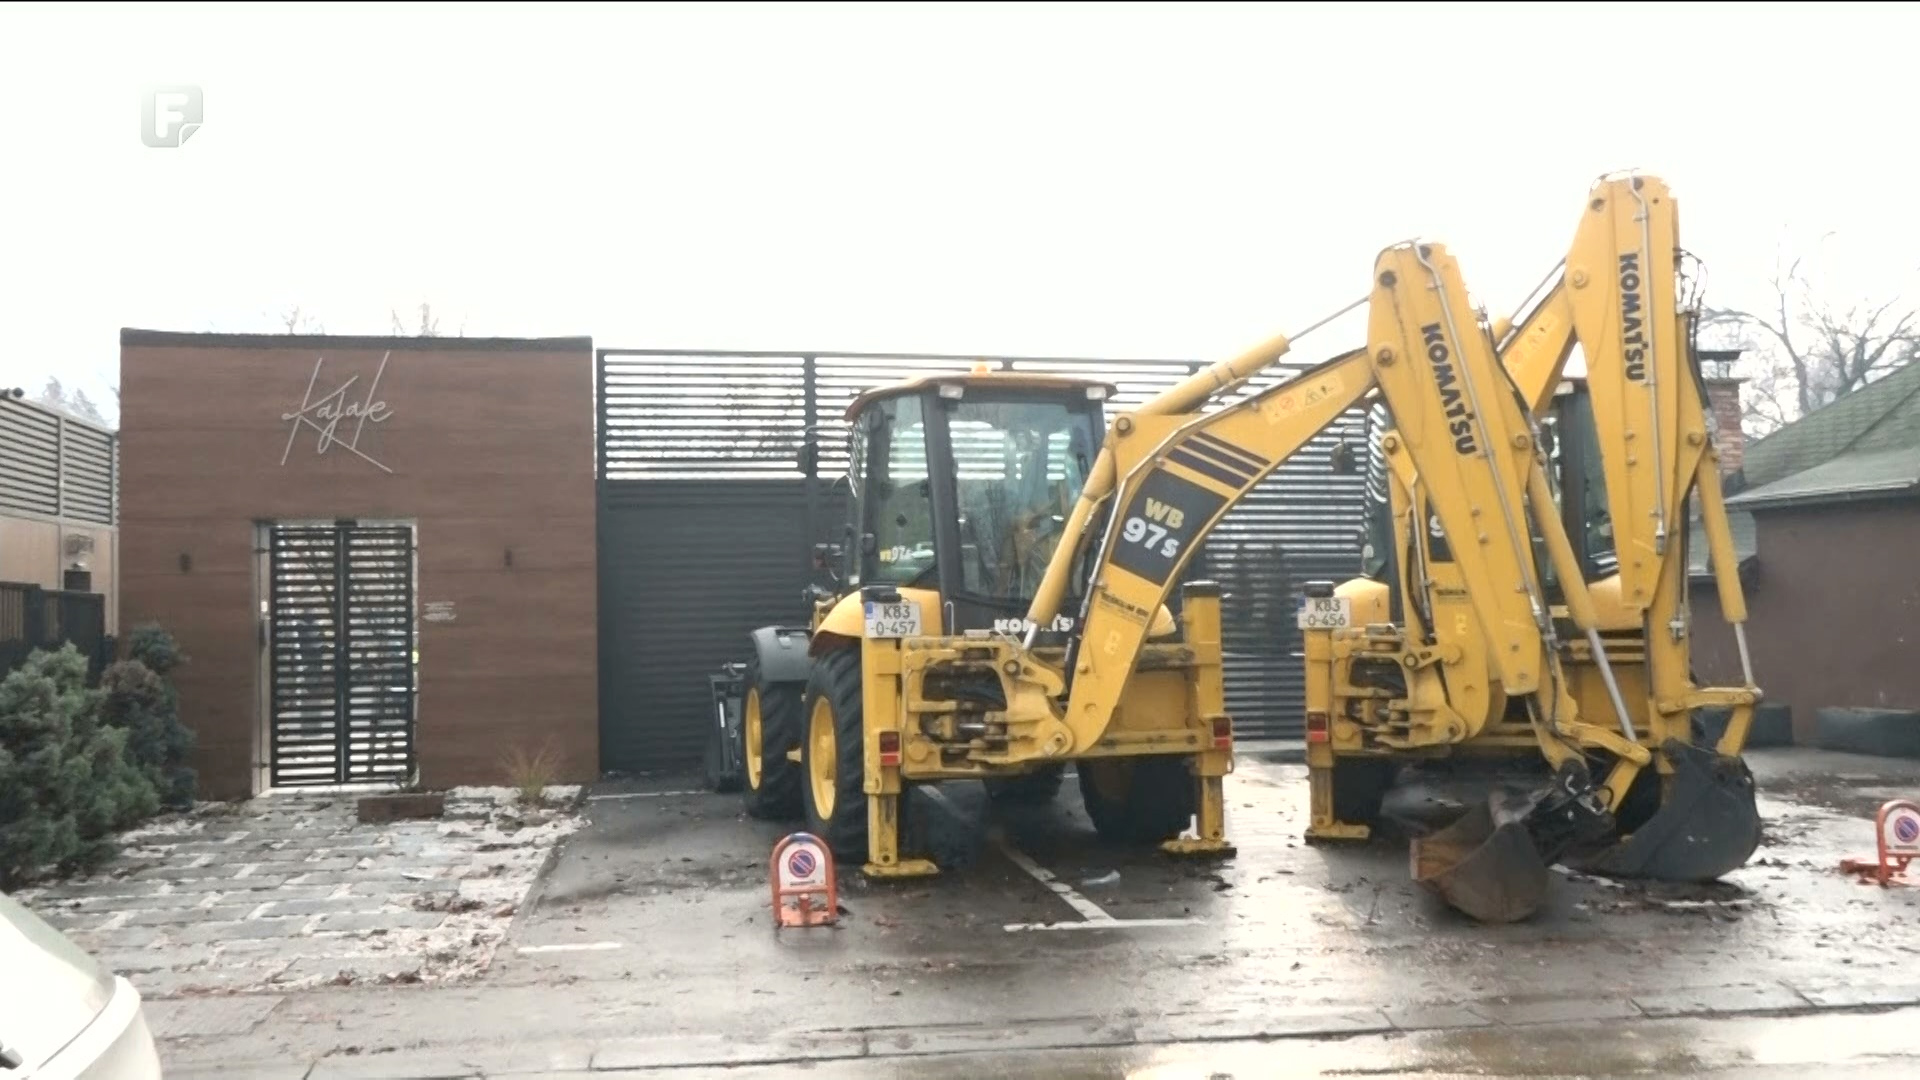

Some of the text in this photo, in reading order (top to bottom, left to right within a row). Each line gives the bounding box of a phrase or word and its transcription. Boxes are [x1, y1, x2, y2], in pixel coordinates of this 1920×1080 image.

[1618, 253, 1649, 381] KOMATSU
[1421, 321, 1478, 455] KOMATSU
[1144, 497, 1185, 529] WB
[883, 605, 911, 619] K83
